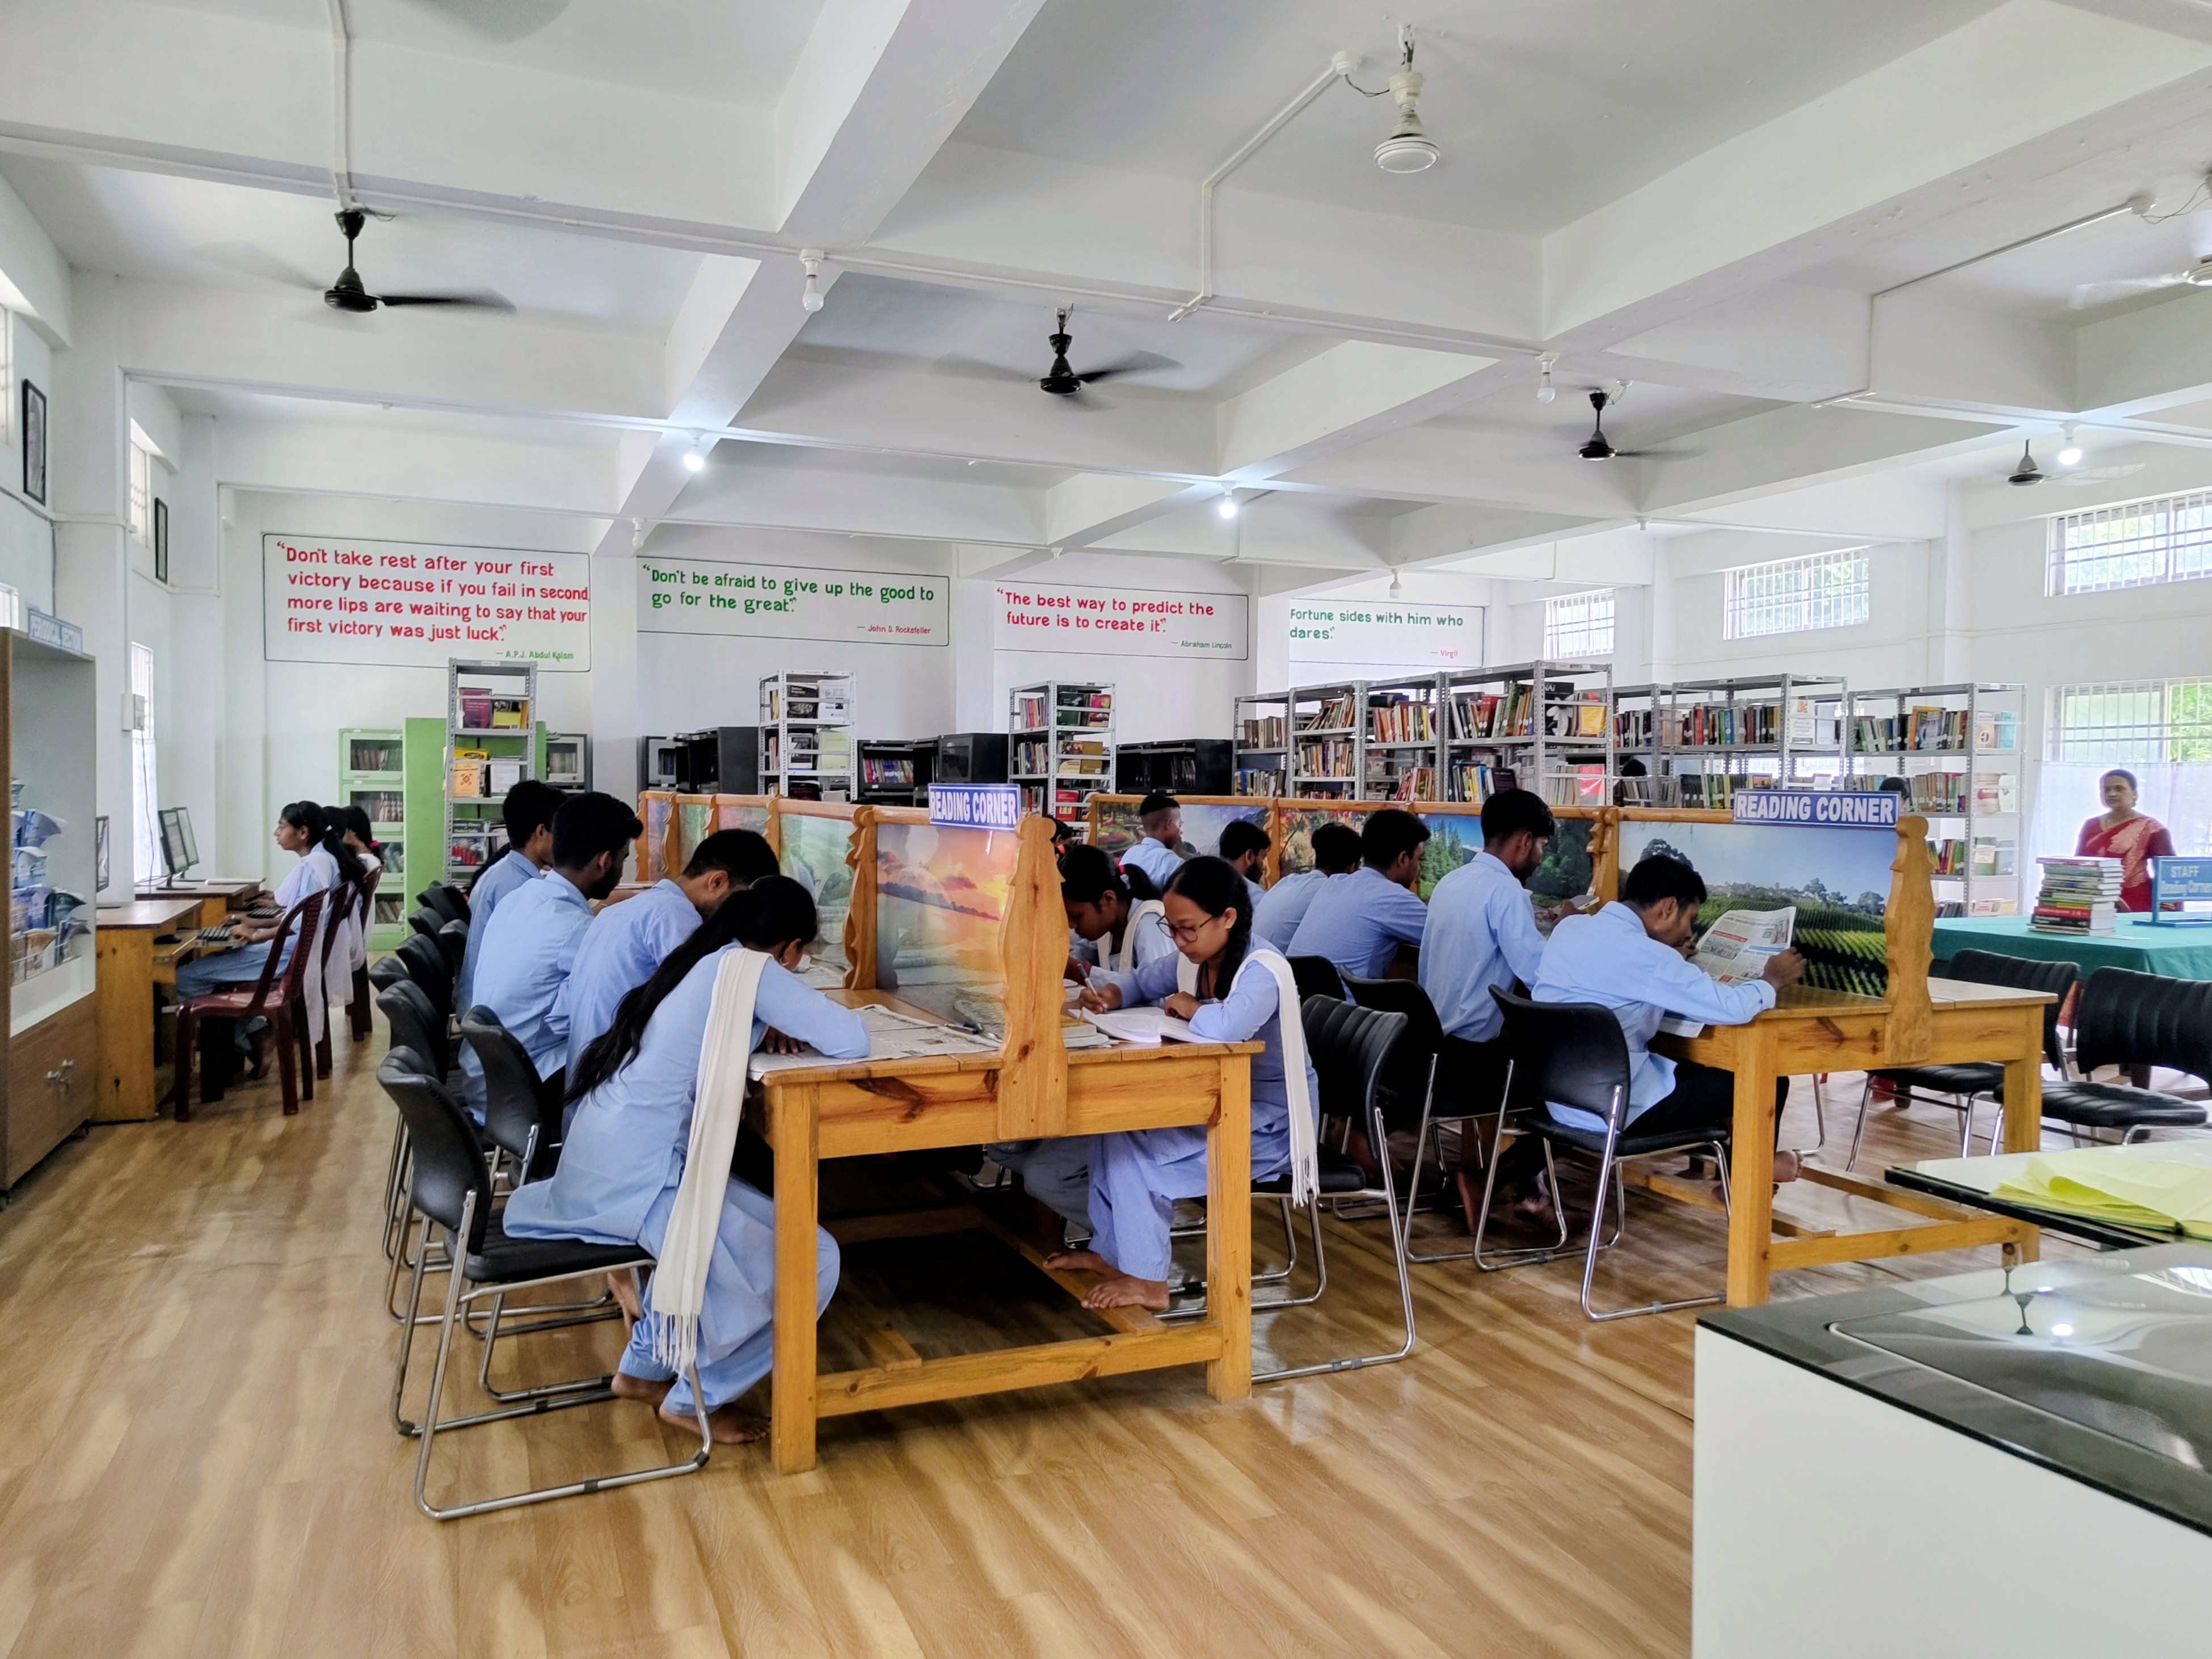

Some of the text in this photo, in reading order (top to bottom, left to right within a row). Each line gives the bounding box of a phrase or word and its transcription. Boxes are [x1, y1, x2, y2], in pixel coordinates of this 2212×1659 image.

[335, 551, 373, 567] take
[381, 555, 416, 570] rest
[424, 555, 467, 572] after
[475, 562, 513, 575] your
[520, 561, 554, 578] first
[289, 572, 351, 590] victory
[359, 576, 436, 594] because
[441, 579, 453, 594] if
[458, 584, 486, 597] you
[492, 582, 517, 597] fail
[521, 585, 537, 598] in
[693, 572, 709, 586] be
[714, 574, 756, 588] afraid
[762, 577, 777, 591] to
[784, 579, 818, 596] give
[825, 583, 844, 596] up
[850, 582, 873, 597] the
[880, 586, 916, 603] good
[920, 587, 934, 601] to
[288, 596, 587, 623] more lips are waiting to say that your
[652, 593, 672, 608] go
[680, 592, 702, 606] for
[710, 594, 737, 609] the
[1036, 594, 1072, 609] best
[1077, 599, 1106, 612] way
[1111, 599, 1127, 612] to
[1132, 601, 1184, 616] predict
[1188, 603, 1215, 617] the
[1006, 610, 1051, 627] future
[1057, 614, 1070, 628] is
[1075, 615, 1090, 629] to
[1095, 619, 1145, 632] create
[1290, 609, 1463, 626] Fortune sides with him who
[288, 617, 322, 633] first
[329, 621, 383, 636] victory
[390, 626, 425, 638] was
[429, 625, 462, 643] just
[1181, 640, 1210, 649] Abraham
[1440, 650, 1459, 659] Virgil
[529, 651, 550, 659] Abdul
[552, 652, 574, 663] Kalam
[930, 791, 1017, 824] READING CORNER
[1737, 795, 1894, 823] READING CORNER
[2171, 866, 2200, 878] STAFF
